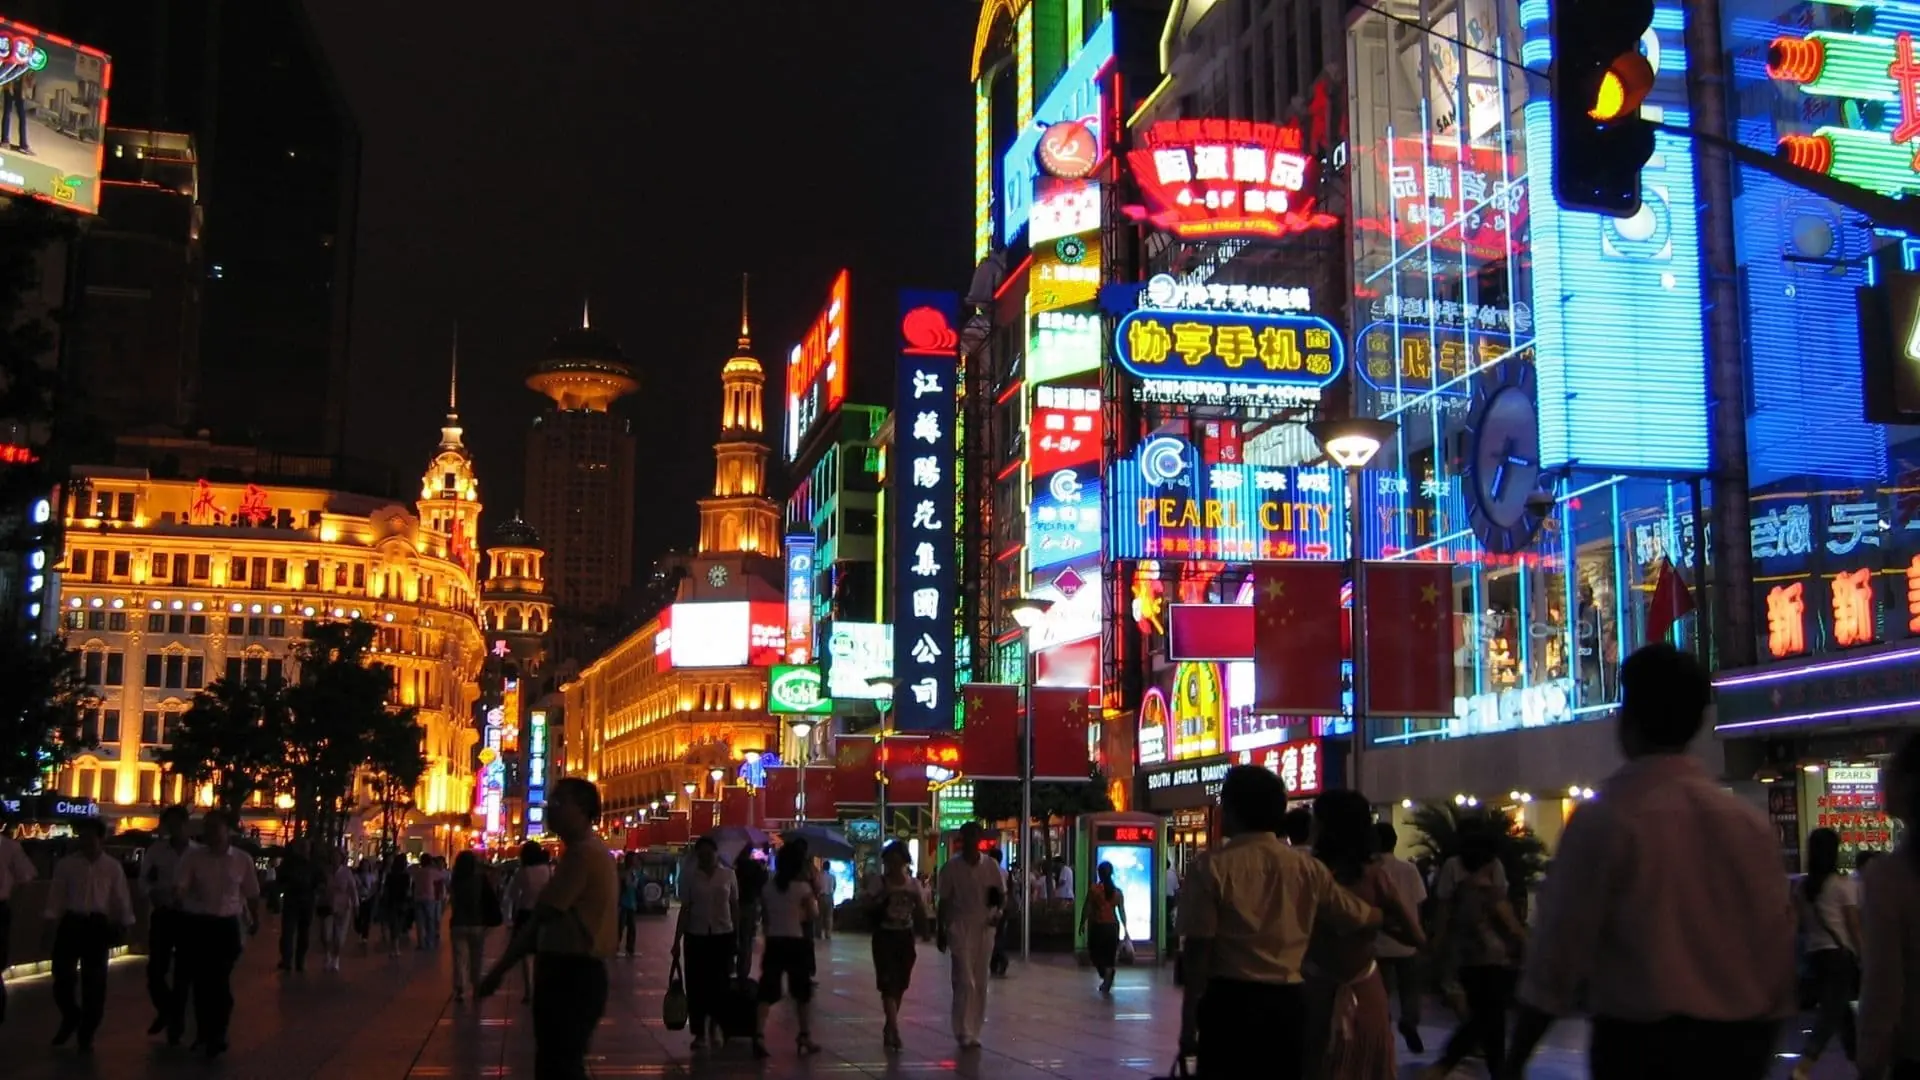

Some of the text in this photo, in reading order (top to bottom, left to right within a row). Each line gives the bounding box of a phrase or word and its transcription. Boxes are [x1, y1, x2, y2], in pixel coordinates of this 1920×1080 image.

[1129, 320, 1332, 375] 协亨手机 商场
[1137, 498, 1333, 531] PEARL CITY
[1148, 771, 1171, 789] SOUTH
[1174, 767, 1199, 786] AFRICA
[1834, 770, 1872, 780] PEARLS
[56, 800, 87, 815] Chez
